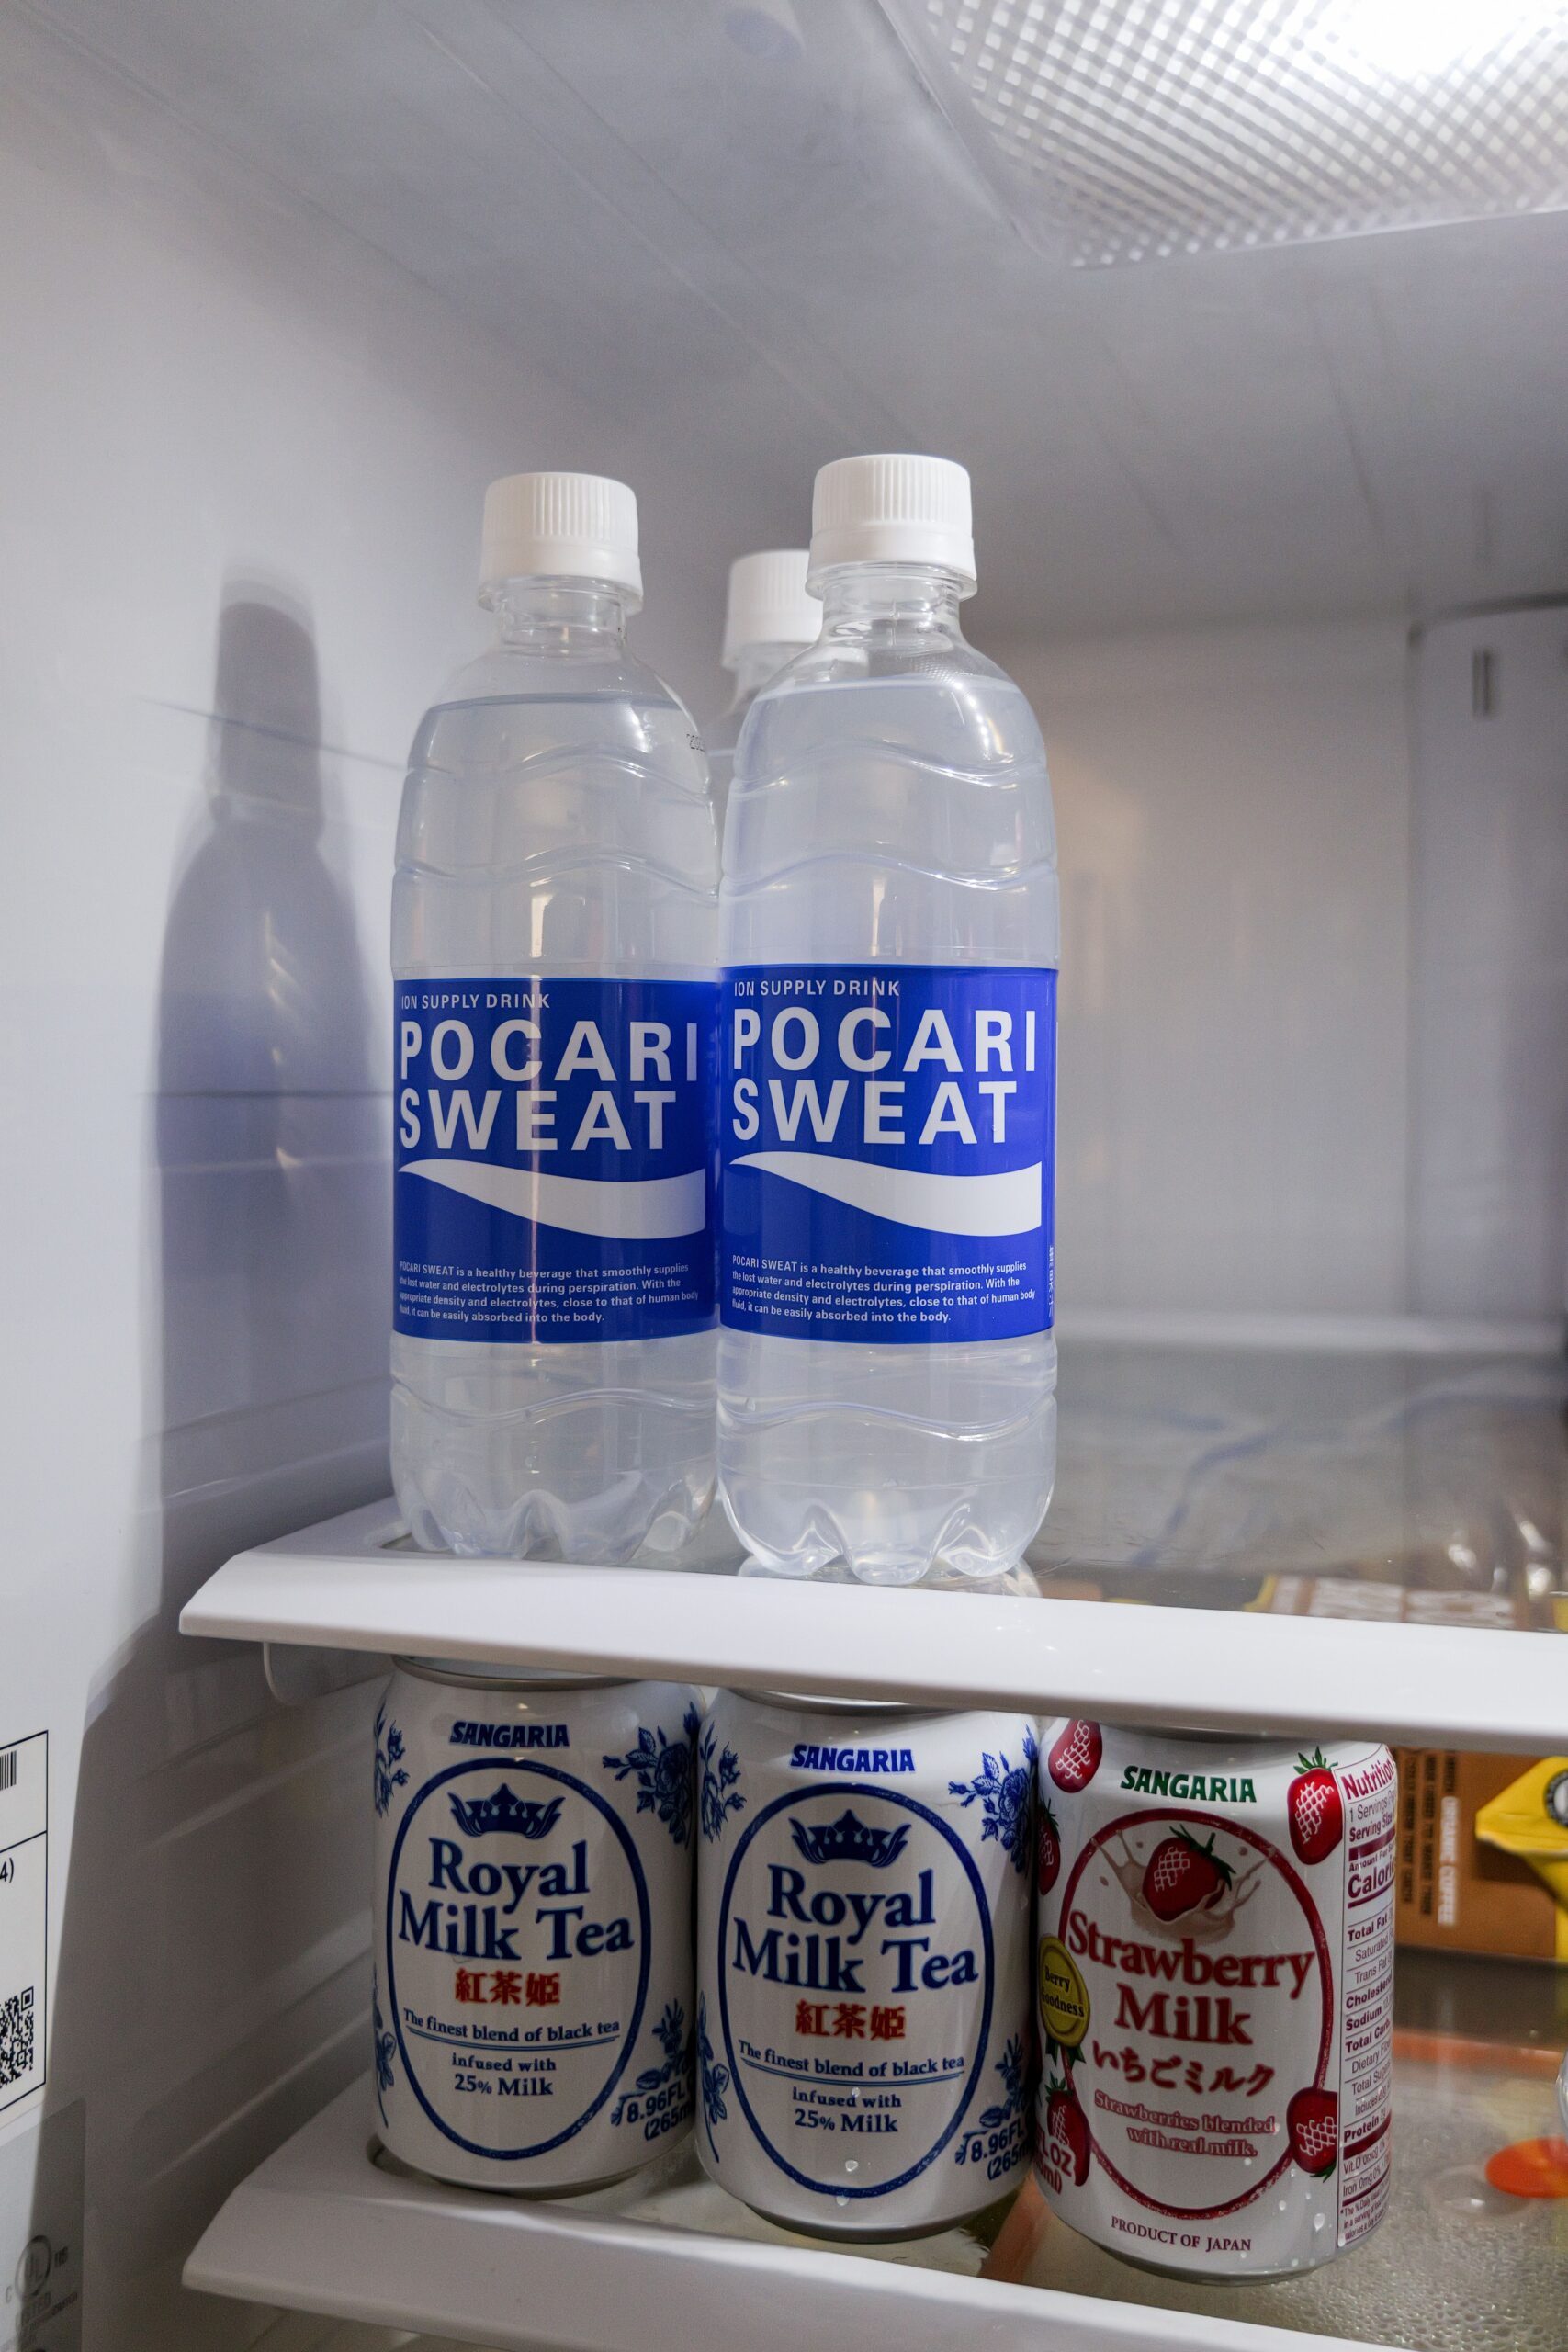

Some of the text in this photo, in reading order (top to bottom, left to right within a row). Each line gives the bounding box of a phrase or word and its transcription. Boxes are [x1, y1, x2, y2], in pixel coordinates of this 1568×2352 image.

[401, 993, 550, 1010] ION SUPPLY DRINK
[734, 980, 899, 997] ION SUPPLY DRINK
[400, 1019, 697, 1082] POCARI
[733, 1006, 1035, 1073] POCARI
[400, 1087, 676, 1151] SWEAT
[732, 1077, 1017, 1145] SWEAT
[400, 1261, 421, 1273] POCARI
[423, 1264, 454, 1275] SWEAT
[457, 1267, 465, 1276] is
[476, 1268, 516, 1280] healthy
[519, 1268, 572, 1280] beverage
[576, 1268, 598, 1278] that
[602, 1266, 652, 1276] smoothly
[654, 1263, 689, 1275] supplies
[732, 1255, 1026, 1278] POCARI SWEAT is a healthy beverage that smoothly supplies
[408, 1278, 681, 1295] lost water and electrolytes during perspiration. With the
[733, 1271, 1019, 1294] the lost water and electrolytes during perspiration. With the
[400, 1291, 698, 1309] appropriate density and electrolytes, close to that of human body
[732, 1298, 951, 1323] fluid, it can be easily absorbed into the body.
[733, 1286, 1035, 1308] appropriate density and electrolytes, close to that of human body
[417, 1308, 604, 1323] can be easily absorbed into the body.
[449, 1721, 570, 1747] SANGARIA
[790, 1744, 915, 1772] SANGARIA
[1120, 1765, 1257, 1804] SANGARIA
[1341, 1758, 1394, 1800] Nutrition
[1349, 1809, 1354, 1822] 1
[1358, 1798, 1387, 1820] Servings
[1349, 1822, 1381, 1842] Serving
[429, 1838, 590, 1914] Royal
[1348, 1856, 1378, 1872] Amount
[766, 1864, 936, 1945] Royal
[399, 1889, 635, 1961] Milk Tea
[1348, 1918, 1374, 1942] Total
[1377, 1912, 1388, 1930] Fat
[732, 1917, 978, 1993] Milk Tea
[1069, 1909, 1315, 2000] Strawberry
[1355, 1934, 1388, 1962] Saturated
[1045, 1965, 1070, 1993] Berry
[1355, 1964, 1377, 1984] Trans
[1379, 1957, 1387, 1973] Fat
[455, 1968, 560, 2007] 紅茶姫
[403, 2007, 620, 2041] The finest blend of black tea
[795, 1998, 905, 2041] 紅茶姫
[1114, 1981, 1253, 2044] Milk
[1346, 2005, 1382, 2031] Sodium
[1346, 2030, 1372, 2053] Total
[451, 2052, 556, 2072] infused with
[739, 2040, 964, 2076] The finest blend of black tea
[1092, 2040, 1275, 2097] いちごミルク
[1352, 2050, 1379, 2074] Dietary
[455, 2074, 553, 2096] 25% Milk
[793, 2086, 901, 2108] infused with
[1352, 2076, 1371, 2095] Total
[795, 2108, 898, 2132] 25% Milk
[1094, 2088, 1276, 2134] Strawberries blended
[971, 2118, 1024, 2162] 8.96FL
[1126, 2127, 1258, 2157] with real milk.
[1344, 2117, 1379, 2143] Protein
[1343, 2182, 1357, 2197] Iron
[1111, 2216, 1251, 2252] PRODUCT OF JAPAN
